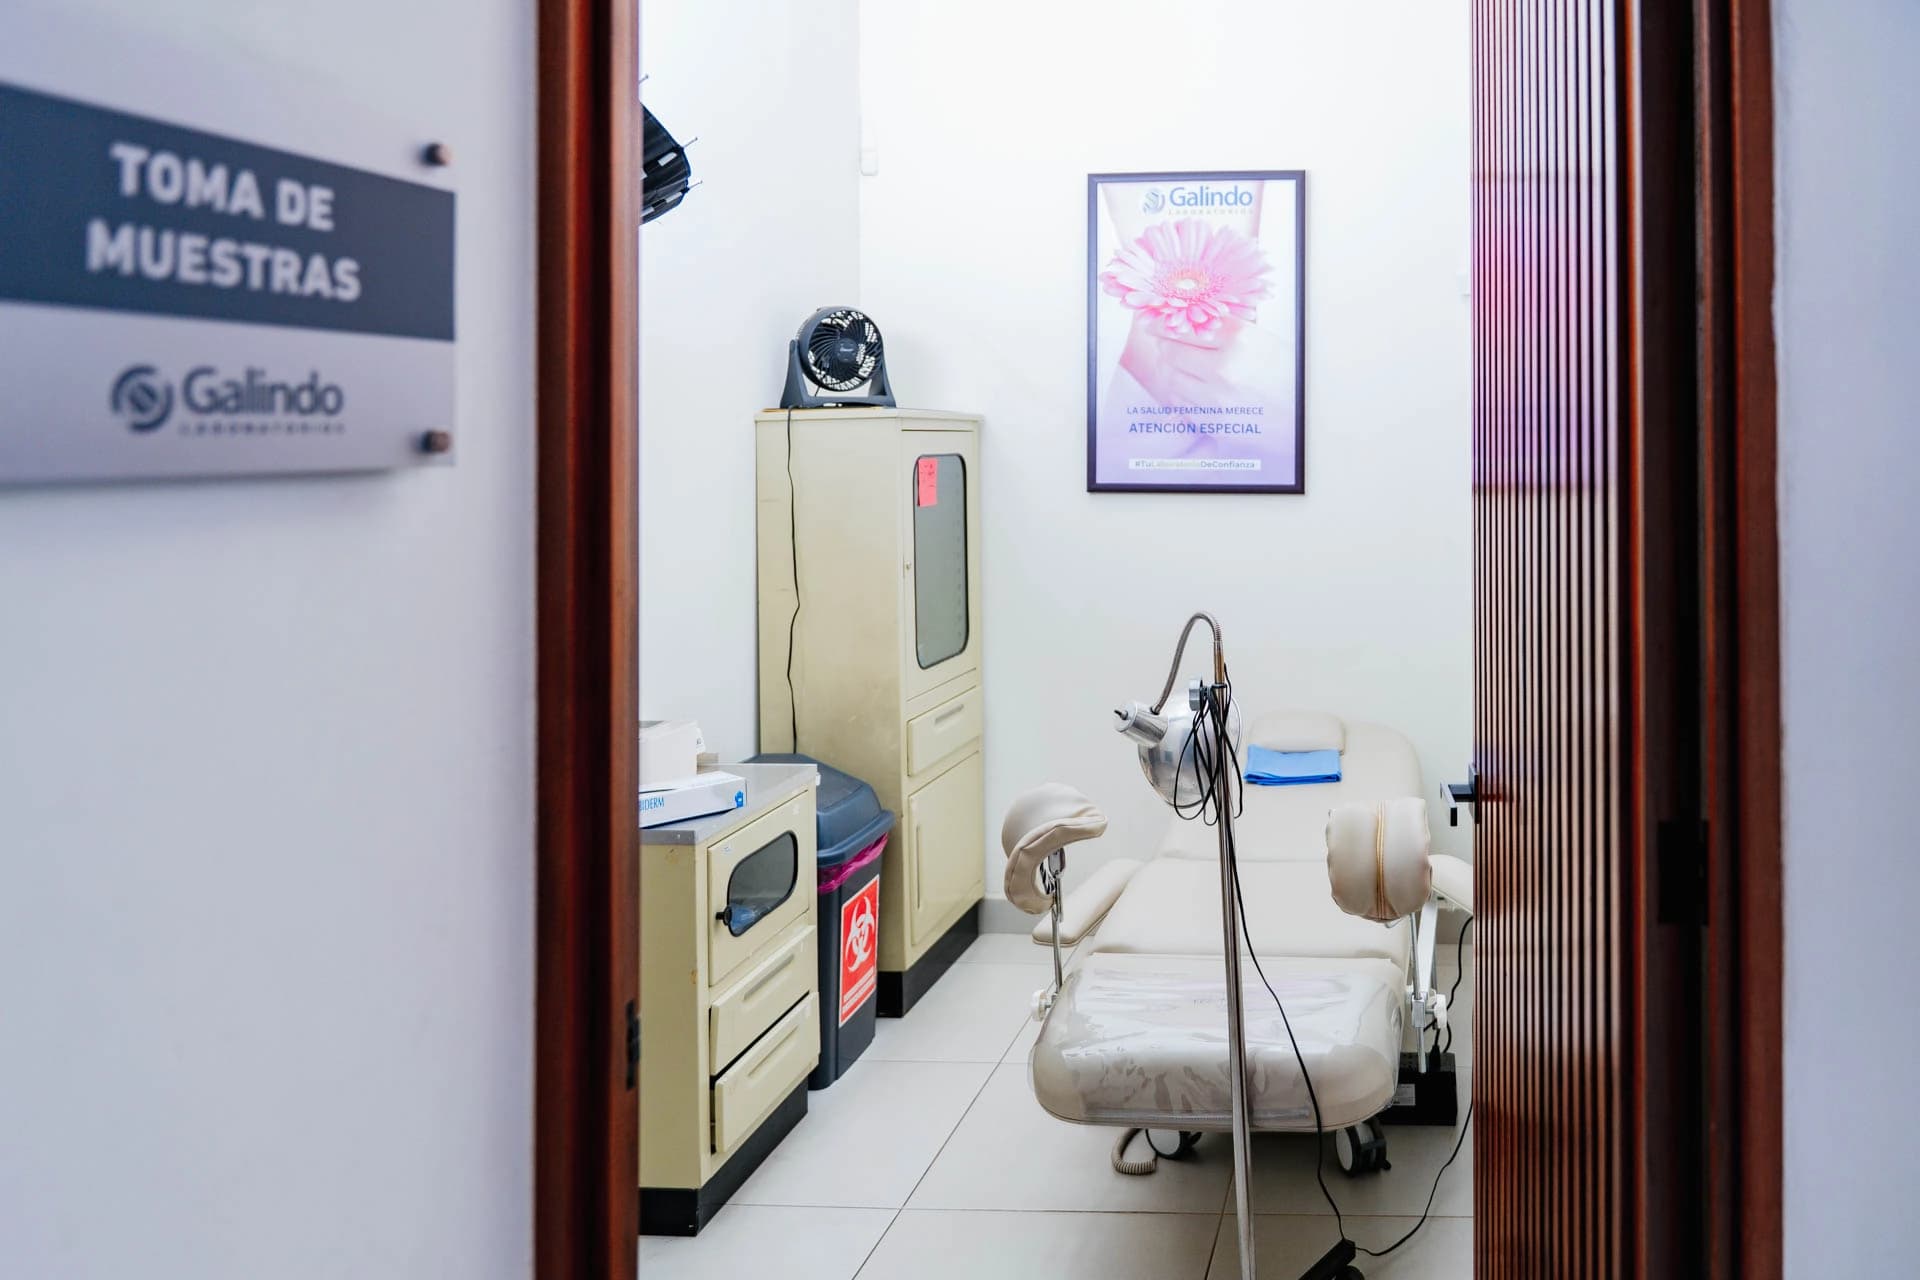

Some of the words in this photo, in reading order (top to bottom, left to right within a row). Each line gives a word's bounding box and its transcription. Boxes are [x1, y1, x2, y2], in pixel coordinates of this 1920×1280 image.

[110, 141, 264, 218] TOMA
[276, 178, 335, 231] DE
[1169, 185, 1253, 206] Galindo
[86, 219, 361, 301] MUESTRAS
[183, 366, 344, 416] Galindo
[1127, 406, 1138, 415] LA
[1141, 406, 1172, 415] SALUD
[1174, 406, 1222, 415] FEMENINA
[1226, 406, 1264, 415] MERECE
[1129, 420, 1196, 434] ATENCIÓN
[1200, 423, 1262, 434] ESPECIAL
